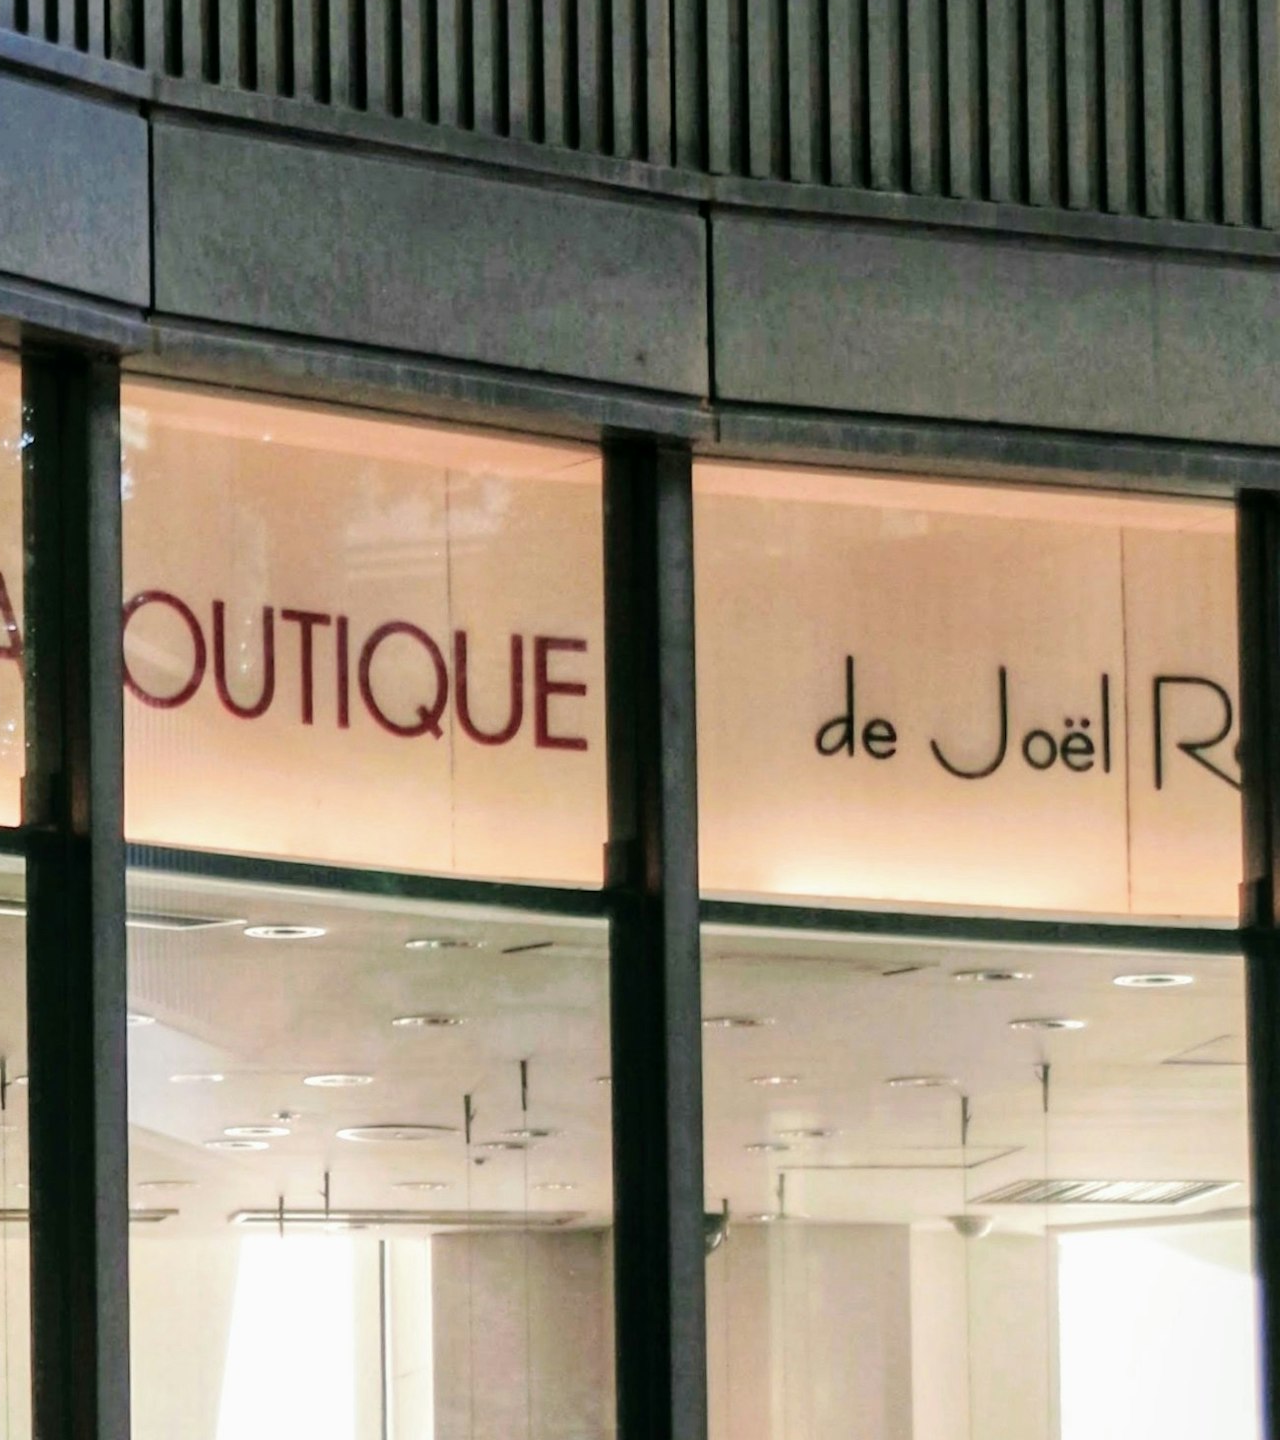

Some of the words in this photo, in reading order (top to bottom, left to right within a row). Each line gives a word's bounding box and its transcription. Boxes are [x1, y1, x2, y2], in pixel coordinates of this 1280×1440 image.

[122, 589, 589, 752] OUTIQUE
[815, 654, 898, 760] de
[929, 664, 1111, 780] Joël
[1153, 675, 1241, 793] R
